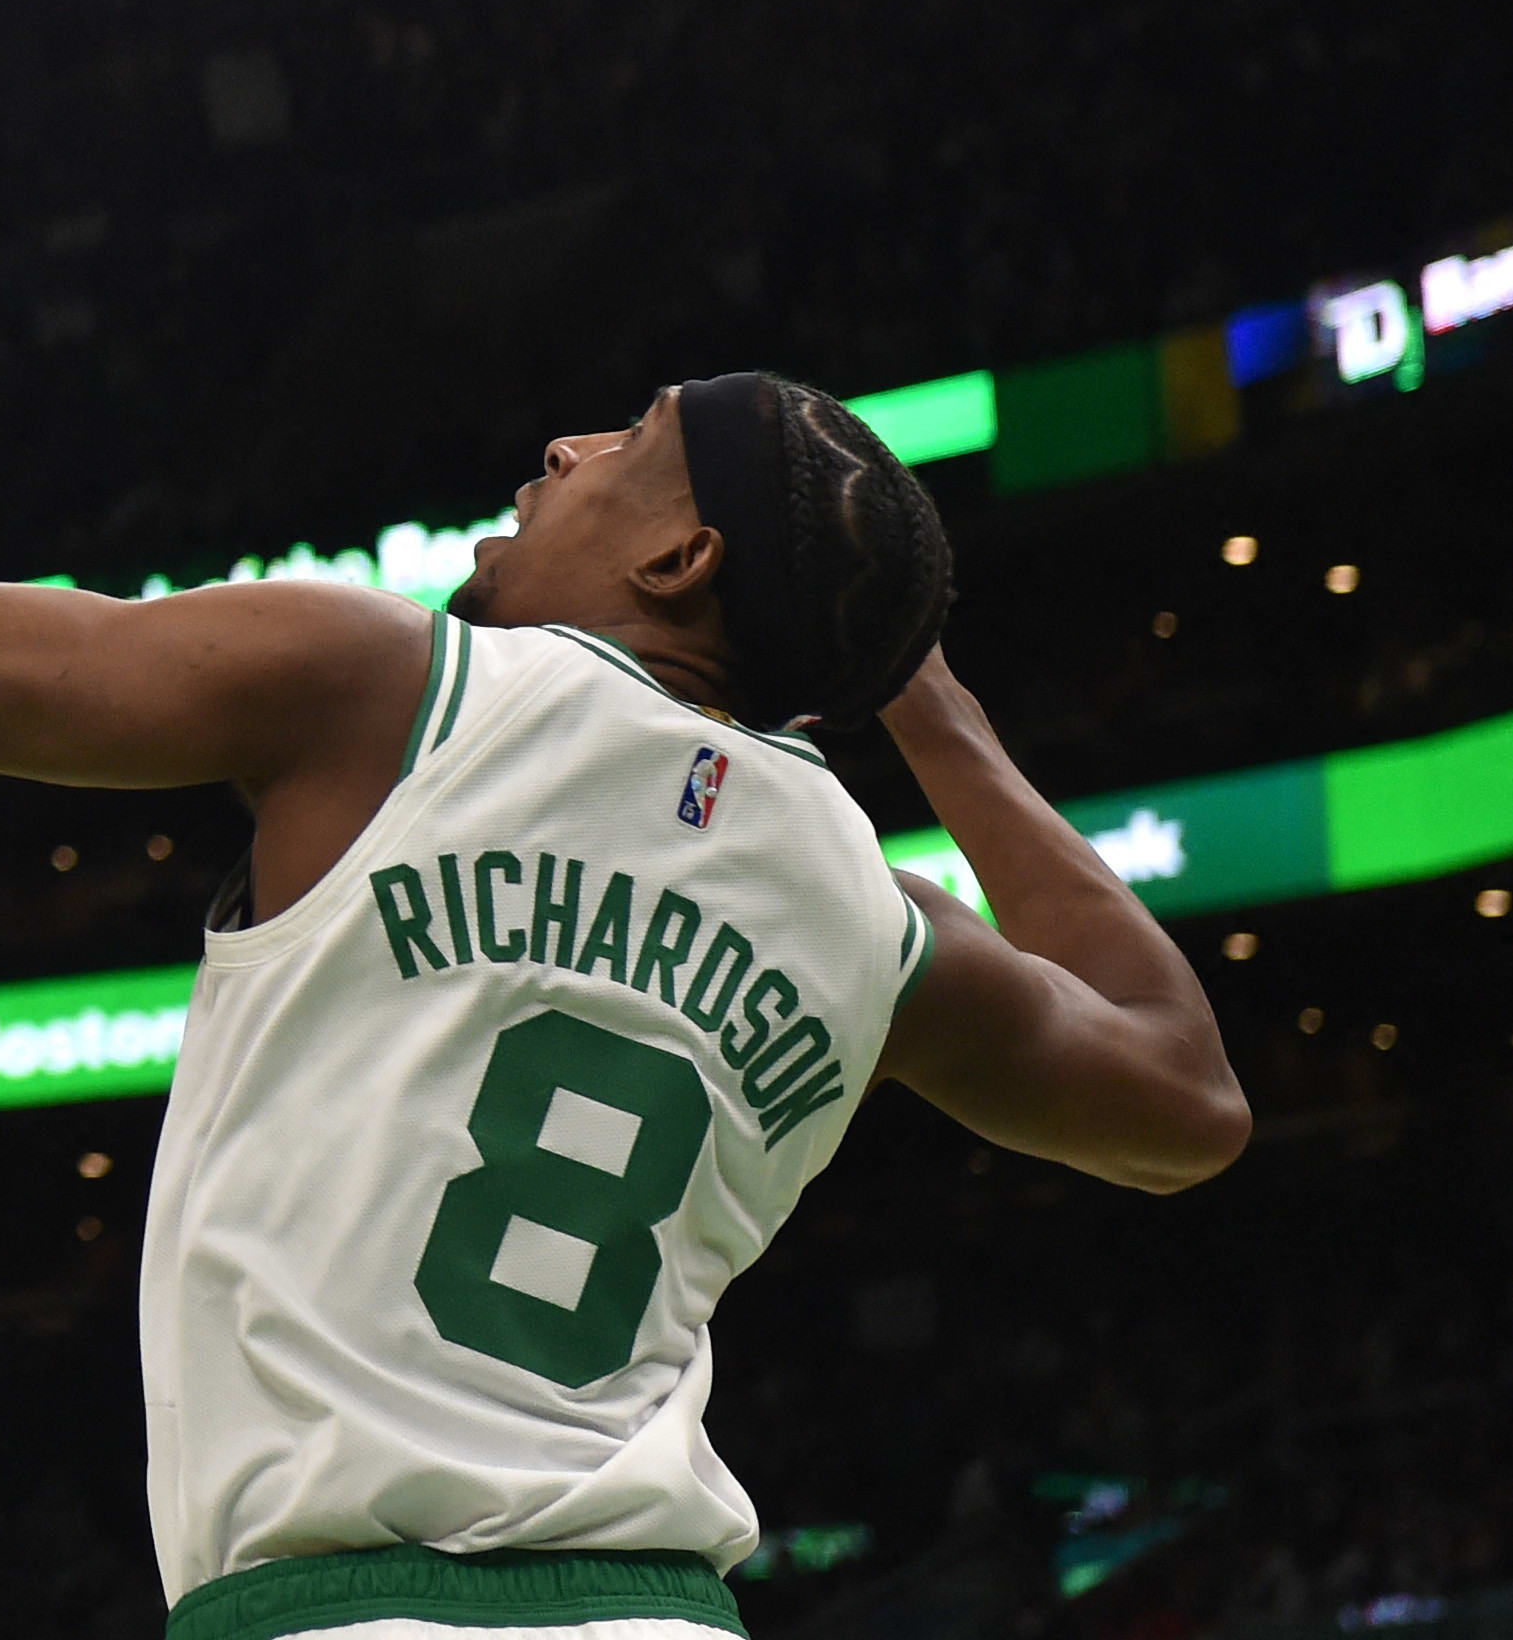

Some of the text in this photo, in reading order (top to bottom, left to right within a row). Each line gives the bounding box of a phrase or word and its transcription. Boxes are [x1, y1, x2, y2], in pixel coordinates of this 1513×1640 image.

[1320, 280, 1408, 383] TD
[369, 851, 845, 1152] RICHARDSON
[413, 1008, 713, 1389] 8
